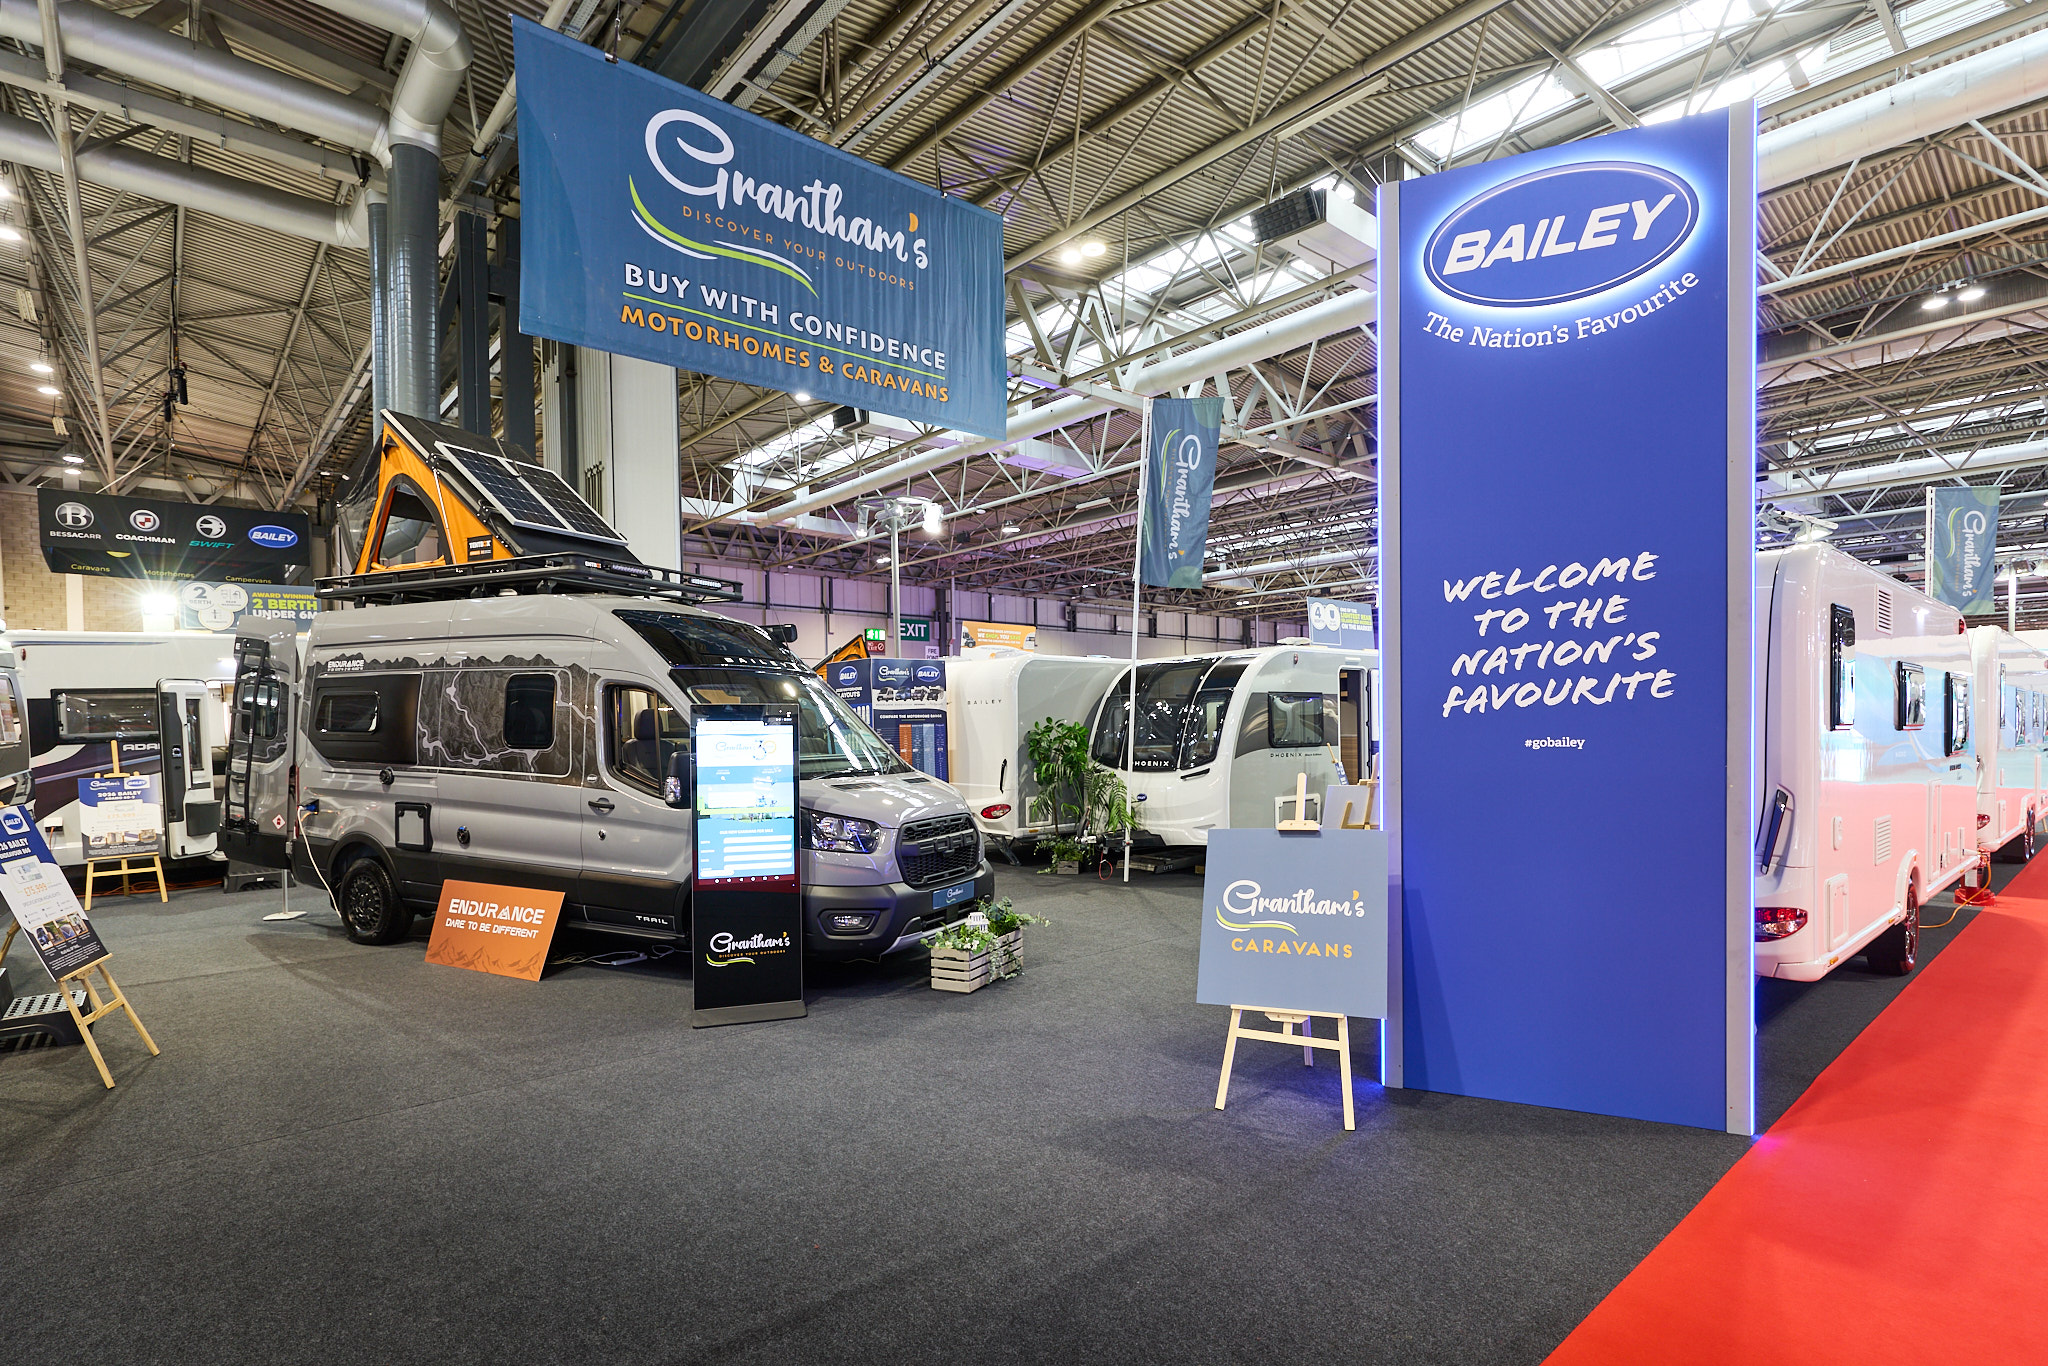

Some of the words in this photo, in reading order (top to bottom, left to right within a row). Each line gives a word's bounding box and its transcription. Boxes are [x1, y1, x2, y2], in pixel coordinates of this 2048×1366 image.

[645, 108, 929, 270] Grantham's
[1443, 193, 1676, 276] BAILEY
[682, 205, 774, 245] DISCOVER
[783, 240, 827, 261] YOUR
[835, 256, 915, 291] OUTDOORS
[1422, 311, 1464, 343] The
[1469, 324, 1570, 348] Nation's
[1576, 270, 1700, 340] Favourite
[624, 263, 690, 297] BUY
[700, 285, 779, 327] WITH
[789, 311, 947, 371] CONFIDENCE
[621, 305, 811, 369] MOTORHOMES
[818, 356, 834, 375] &
[842, 363, 949, 402] CARAVANS
[1168, 434, 1202, 560] Grantham's
[49, 531, 102, 540] BESSACARR
[115, 534, 176, 544] COACHMAN
[251, 531, 295, 542] BAILEY
[189, 540, 235, 549] SWIFT
[1962, 510, 1987, 597] Grantham's
[71, 563, 110, 572] Caravans
[143, 569, 195, 579] Motorhomes
[225, 575, 272, 584] Campervans
[1443, 551, 1660, 603] WELCOME
[193, 586, 207, 599] 2
[253, 600, 263, 609] 2
[268, 600, 318, 610] BERTH
[252, 609, 296, 620] UNDER
[1473, 607, 1530, 637] TO
[1543, 594, 1630, 630] THE
[900, 623, 927, 638] EXIT
[1451, 631, 1661, 677] NATION'S
[327, 660, 364, 668] ENDURANCE
[840, 672, 857, 681] BAILEY
[1442, 668, 1677, 718] FAVOURITE
[122, 743, 160, 751] ADA
[1524, 736, 1586, 750] #gobailey
[5, 817, 21, 826] BAILEY
[0, 842, 8, 851] 26
[8, 837, 29, 849] BAILEY
[1223, 879, 1365, 918] Grantham's
[448, 898, 546, 925] ENDURANCE
[635, 915, 668, 925] TRAIL
[445, 918, 466, 928] DARE
[467, 920, 478, 931] TO
[478, 922, 491, 932] BE
[492, 924, 539, 939] DIFFERENT
[709, 931, 791, 953] Grantham's
[1231, 937, 1353, 959] CARAVANS
